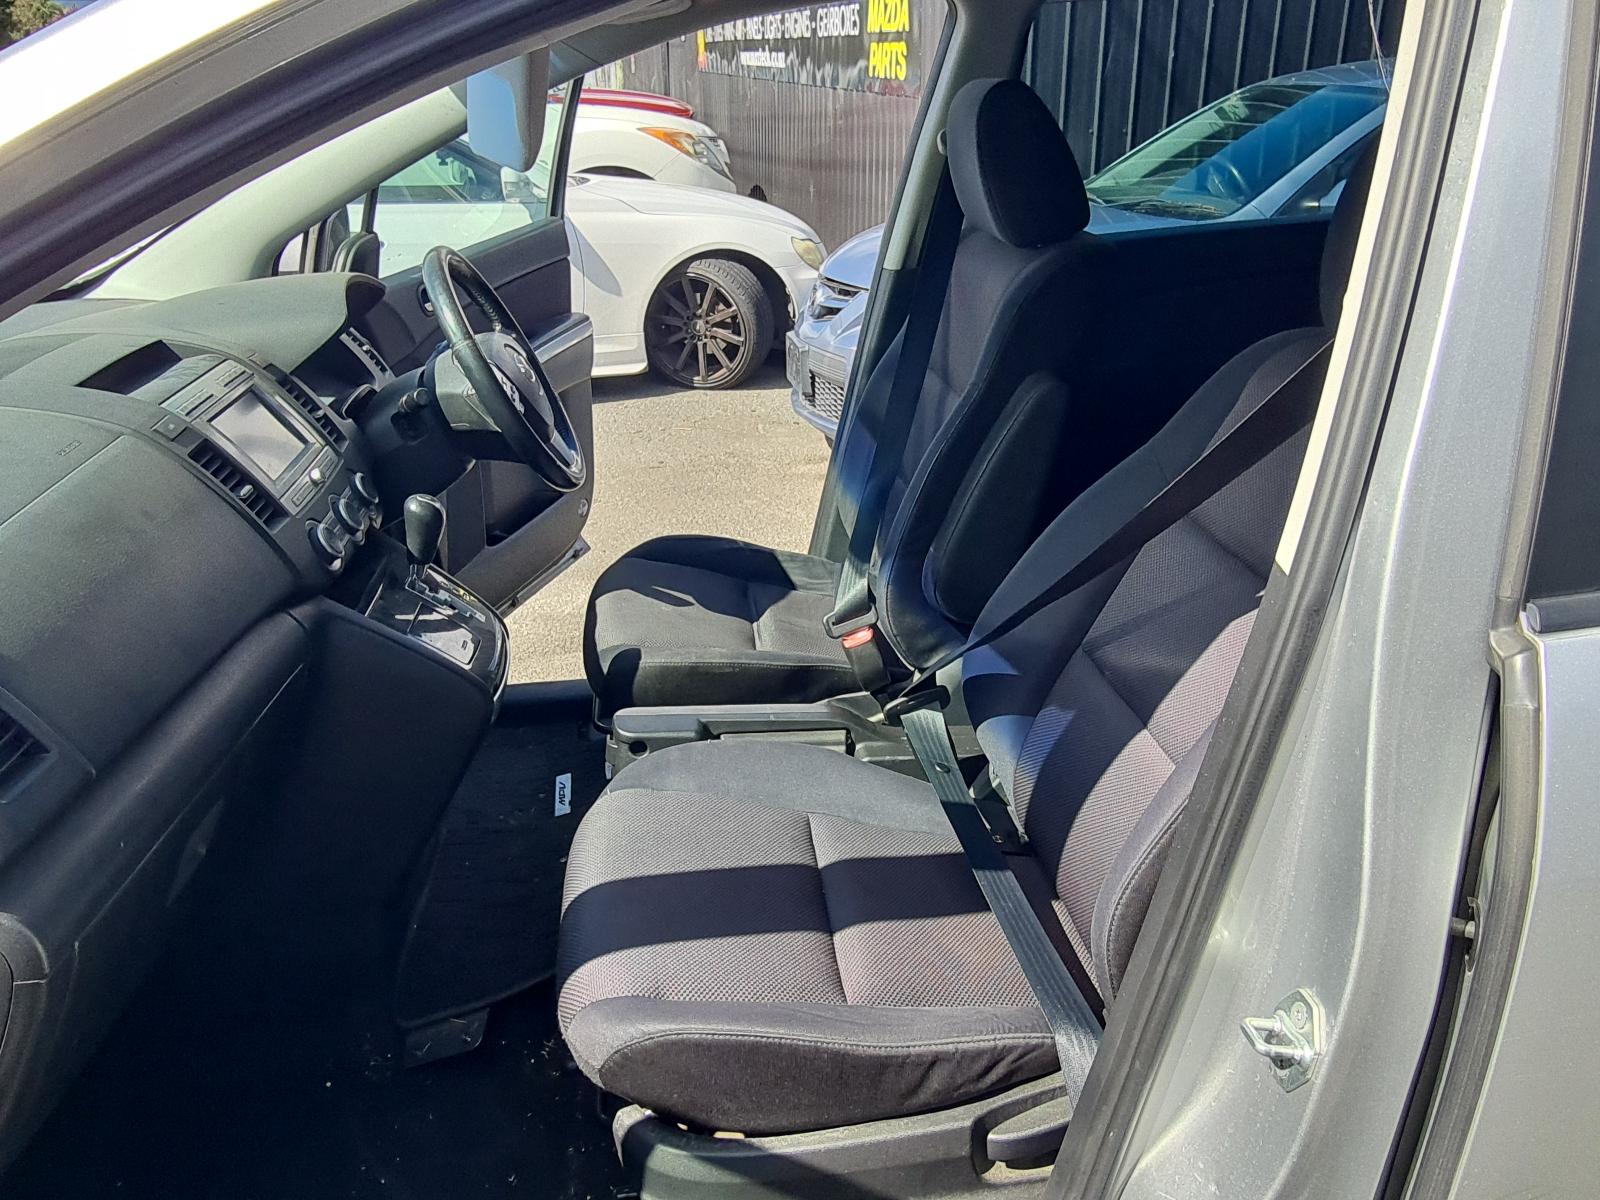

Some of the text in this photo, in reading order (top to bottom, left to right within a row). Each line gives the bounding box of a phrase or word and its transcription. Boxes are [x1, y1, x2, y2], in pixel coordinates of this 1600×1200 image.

[764, 14, 782, 39] LIGHTS
[784, 10, 811, 39] ENGINES
[816, 4, 860, 36] GEARBOXES
[867, 0, 910, 32] MAZDA
[868, 41, 907, 81] PARTS
